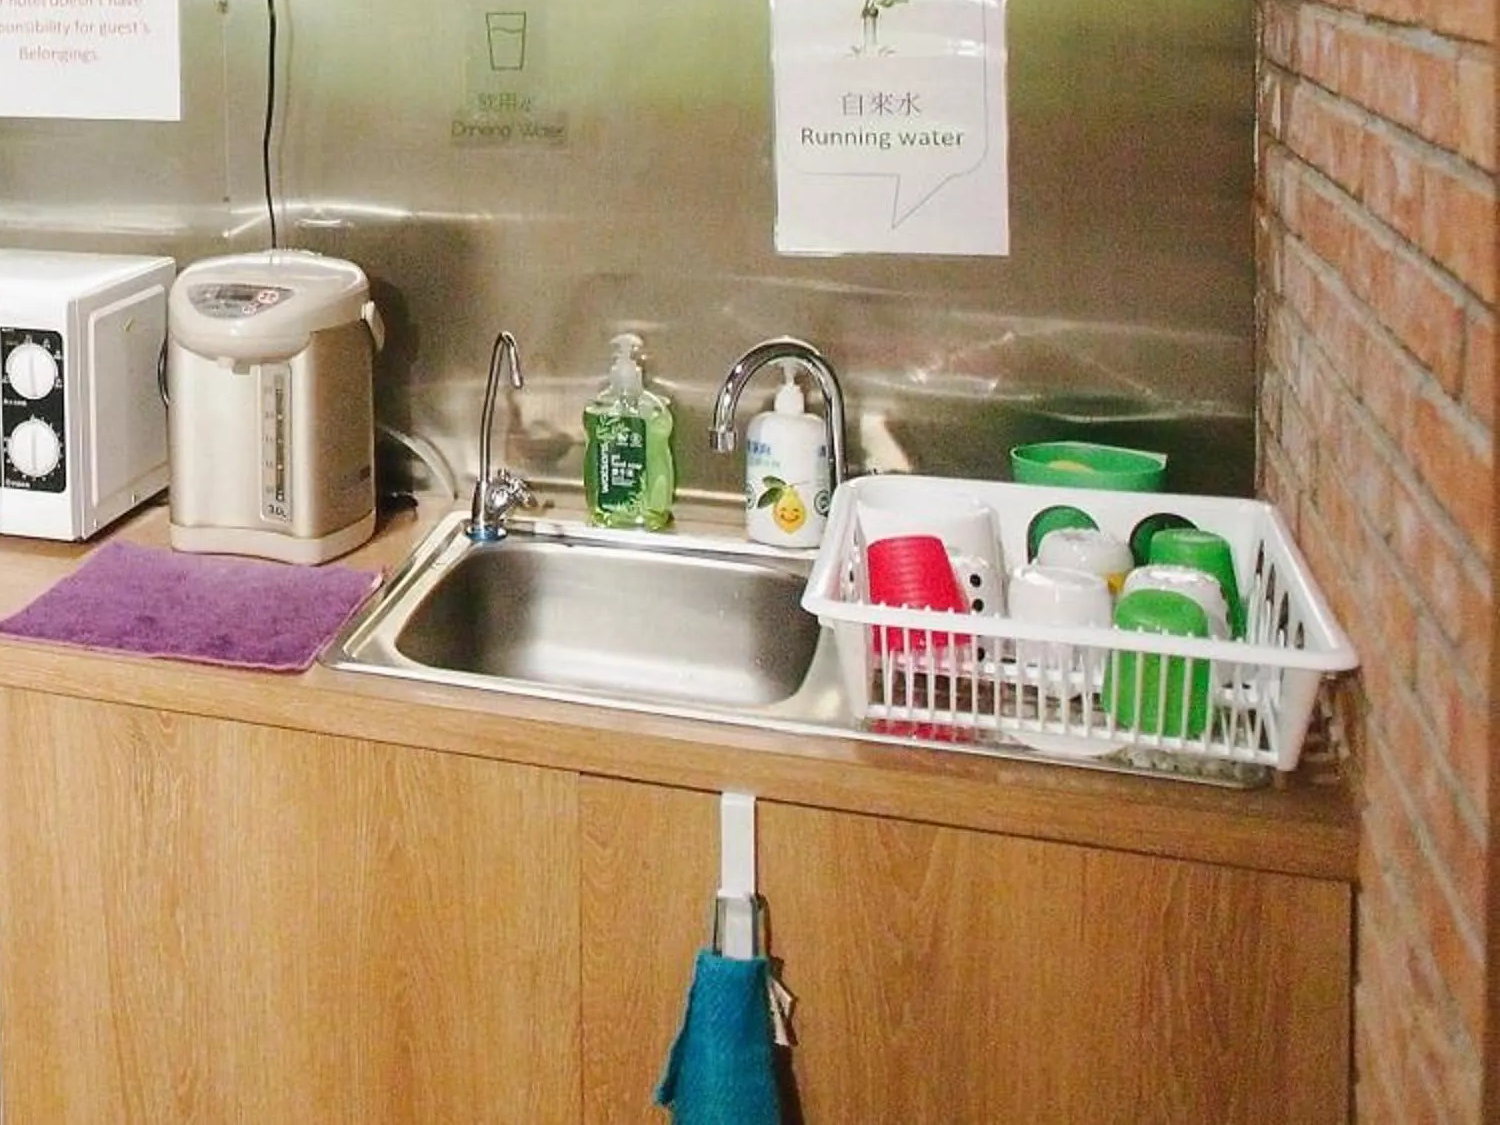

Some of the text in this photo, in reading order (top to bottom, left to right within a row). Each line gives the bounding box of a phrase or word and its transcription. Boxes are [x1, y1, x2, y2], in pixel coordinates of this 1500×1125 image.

[75, 20, 94, 34] for
[98, 20, 151, 37] guest's
[840, 91, 923, 116] 自來水
[801, 127, 966, 150] Running water
